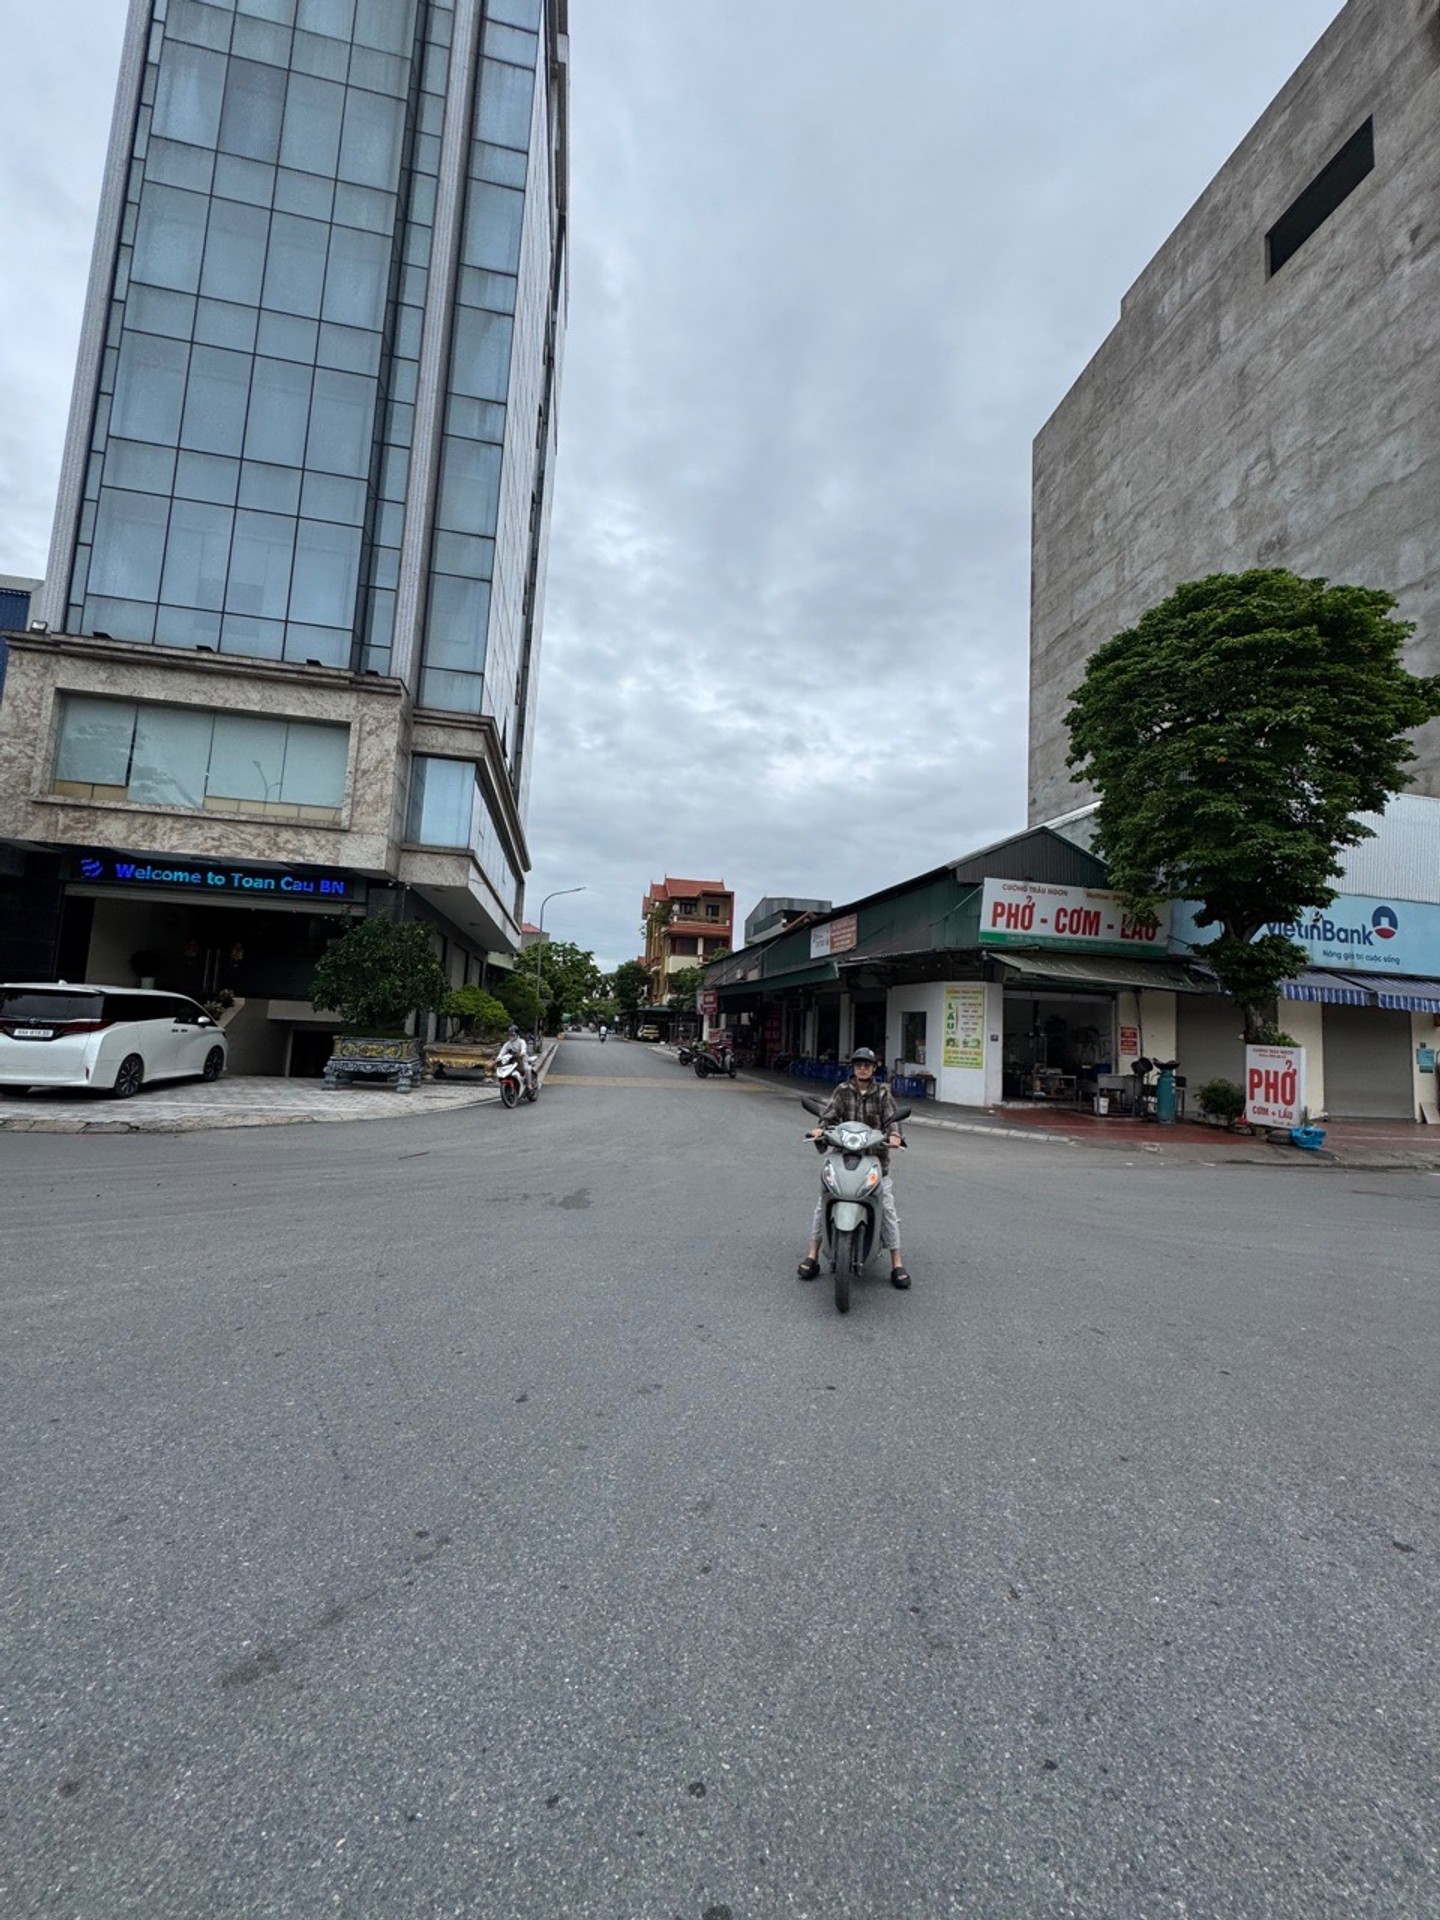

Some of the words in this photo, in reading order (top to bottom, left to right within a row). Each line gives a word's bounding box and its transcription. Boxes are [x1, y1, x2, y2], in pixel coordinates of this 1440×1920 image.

[116, 863, 201, 883] Welcome
[207, 871, 226, 886] to
[231, 873, 275, 889] Toan
[280, 876, 314, 892] Cau
[320, 879, 344, 894] BN
[991, 895, 1036, 931] PHỞ
[1054, 906, 1102, 937] CƠM
[1249, 1060, 1297, 1106] PHỞ
